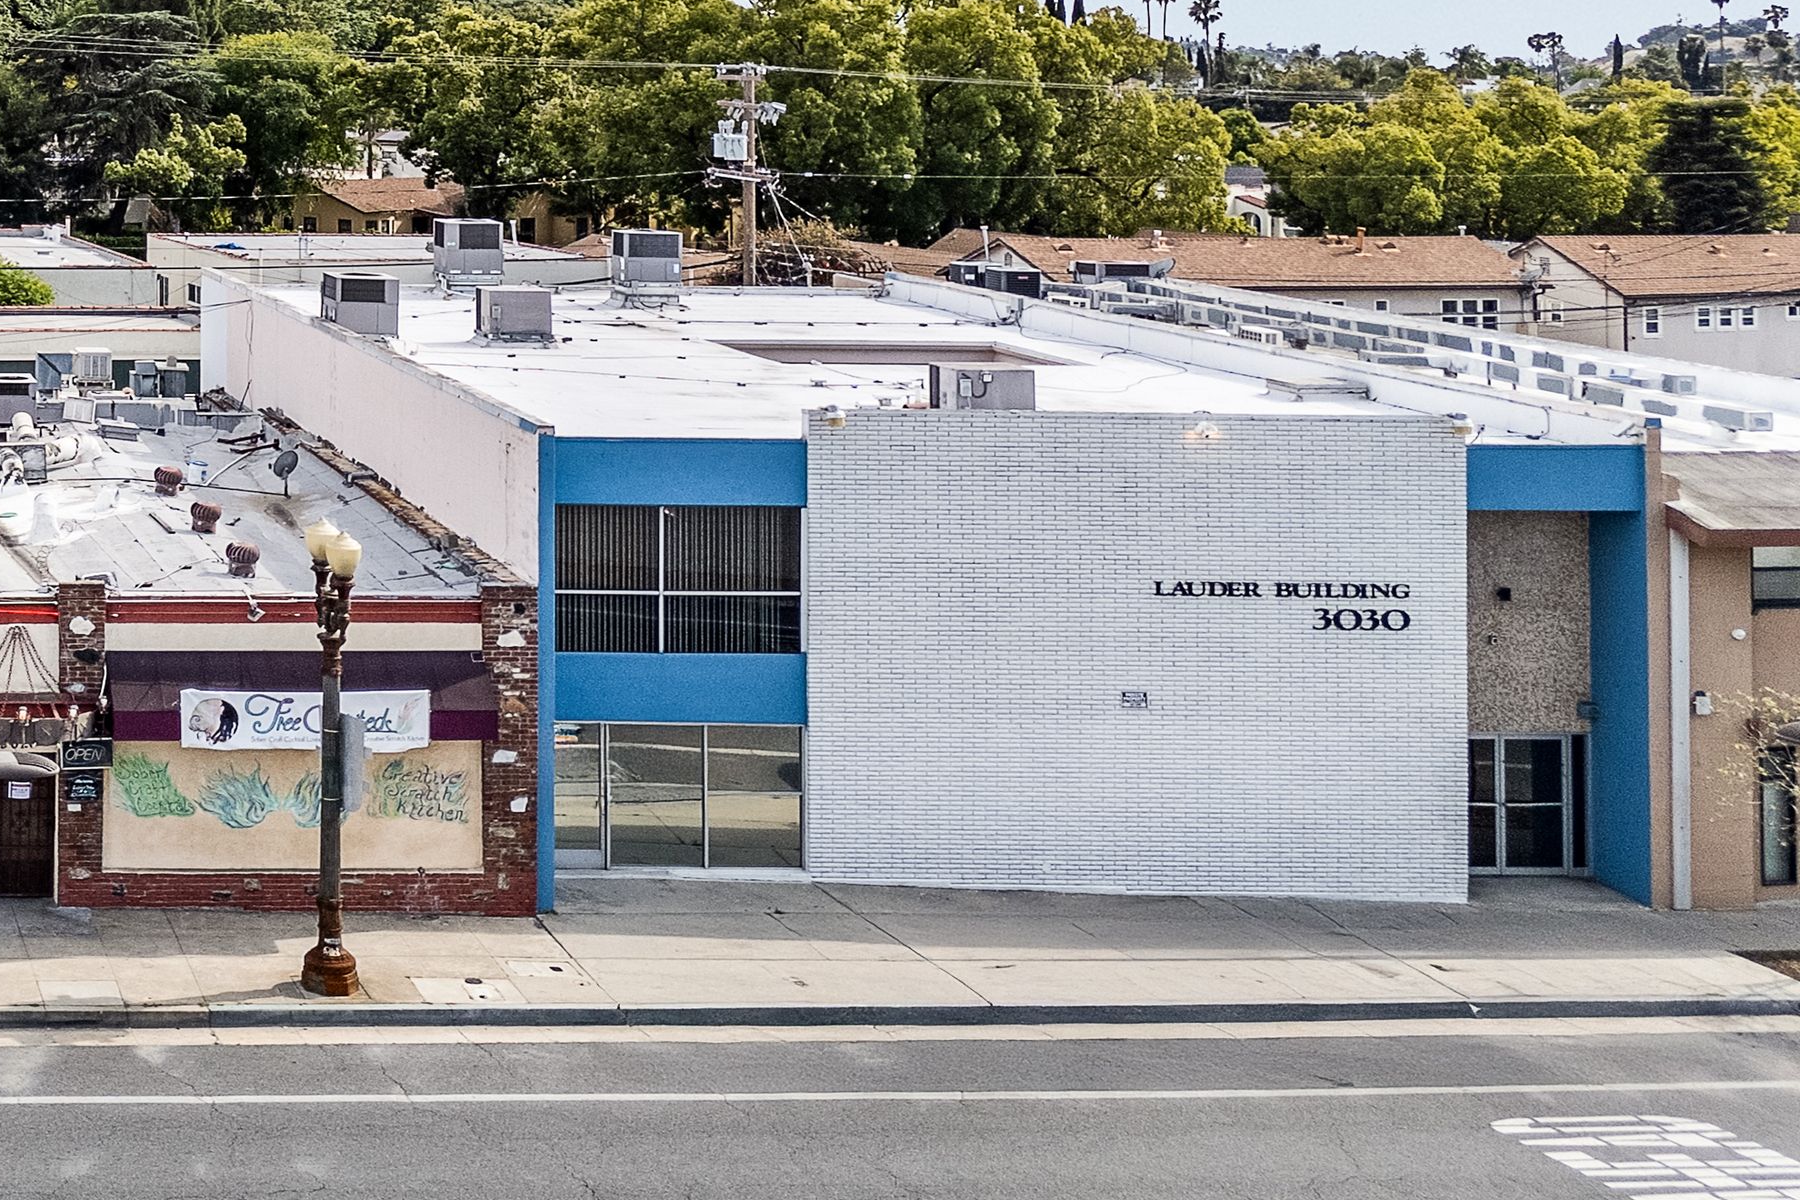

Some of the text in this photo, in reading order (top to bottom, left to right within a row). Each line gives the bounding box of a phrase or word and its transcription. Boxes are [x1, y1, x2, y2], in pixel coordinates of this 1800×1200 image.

[1153, 581, 1410, 598] LAUDER BUILDING
[1313, 608, 1411, 631] 3030
[65, 748, 103, 761] OPEN
[382, 760, 462, 785] Creative
[384, 783, 453, 803] Scratch
